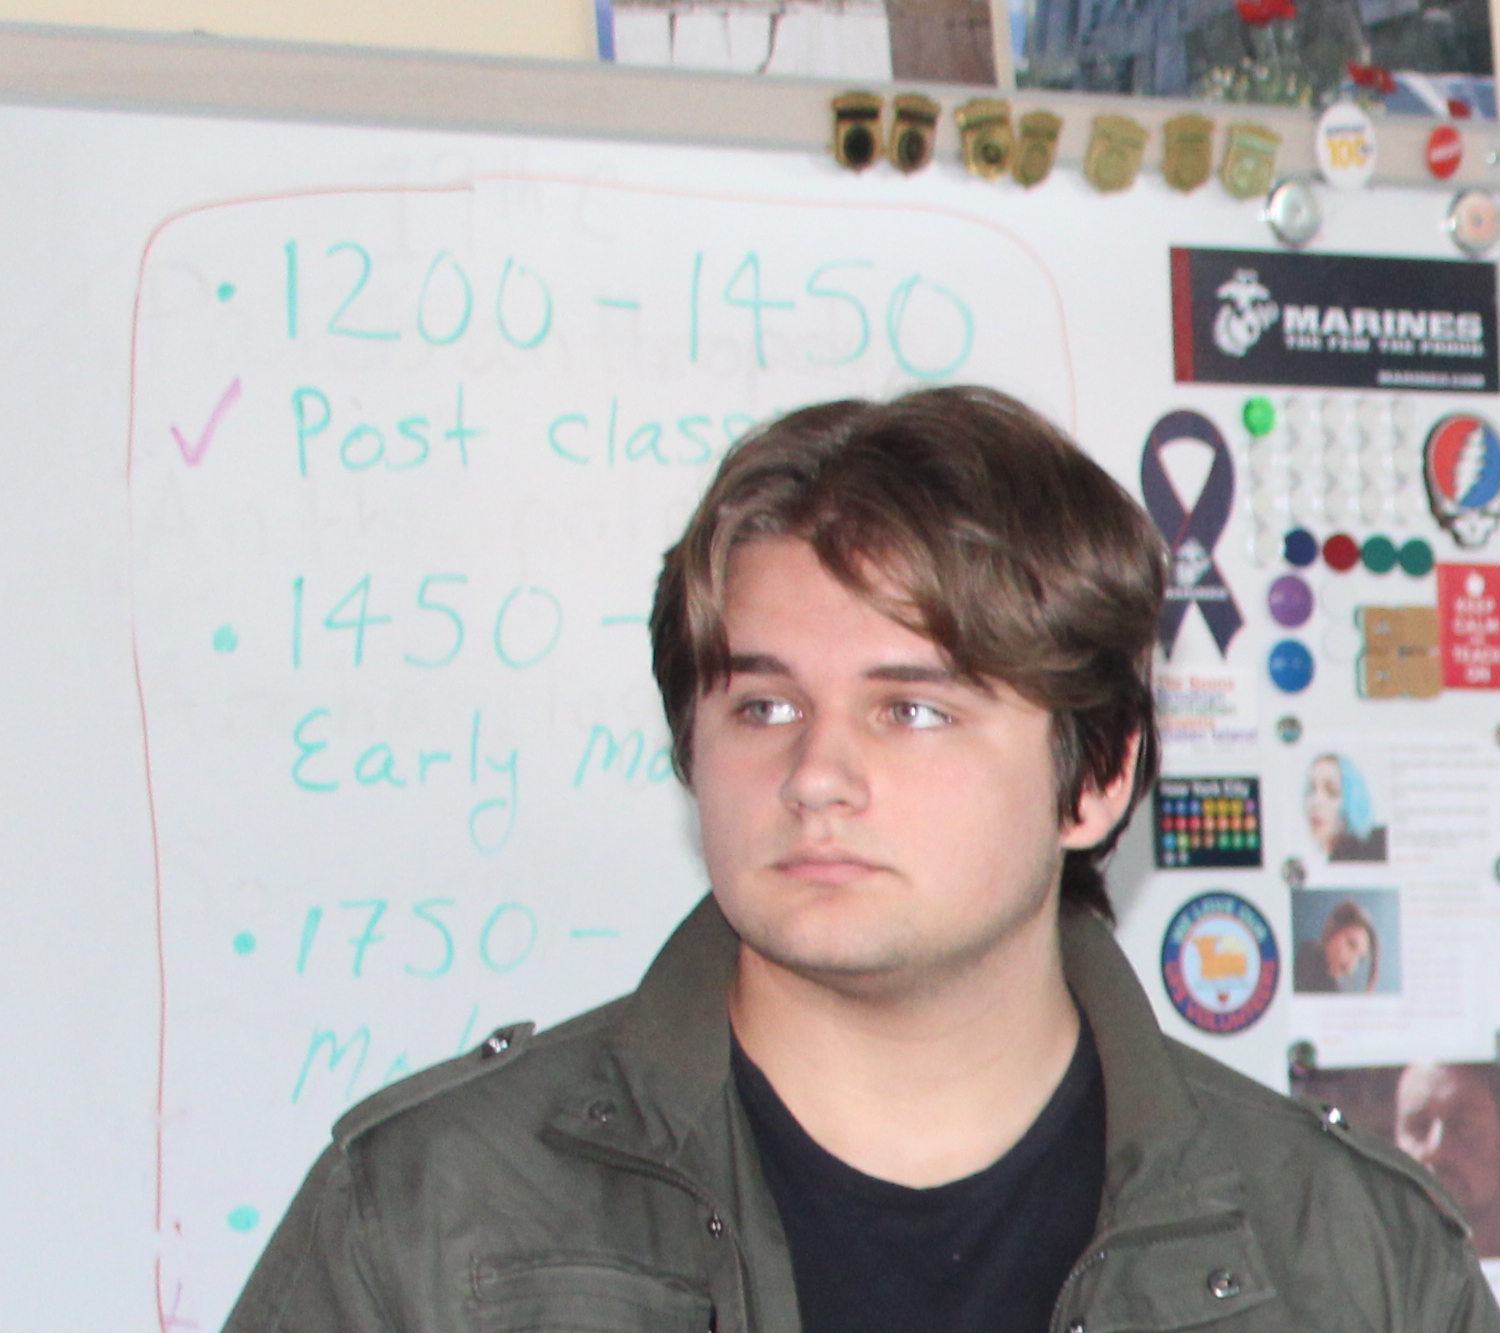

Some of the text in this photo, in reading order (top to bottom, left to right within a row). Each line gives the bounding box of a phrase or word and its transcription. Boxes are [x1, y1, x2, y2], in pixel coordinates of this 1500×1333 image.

[1282, 303, 1484, 341] MARINES
[293, 383, 485, 477] Post
[291, 707, 521, 857] Early
